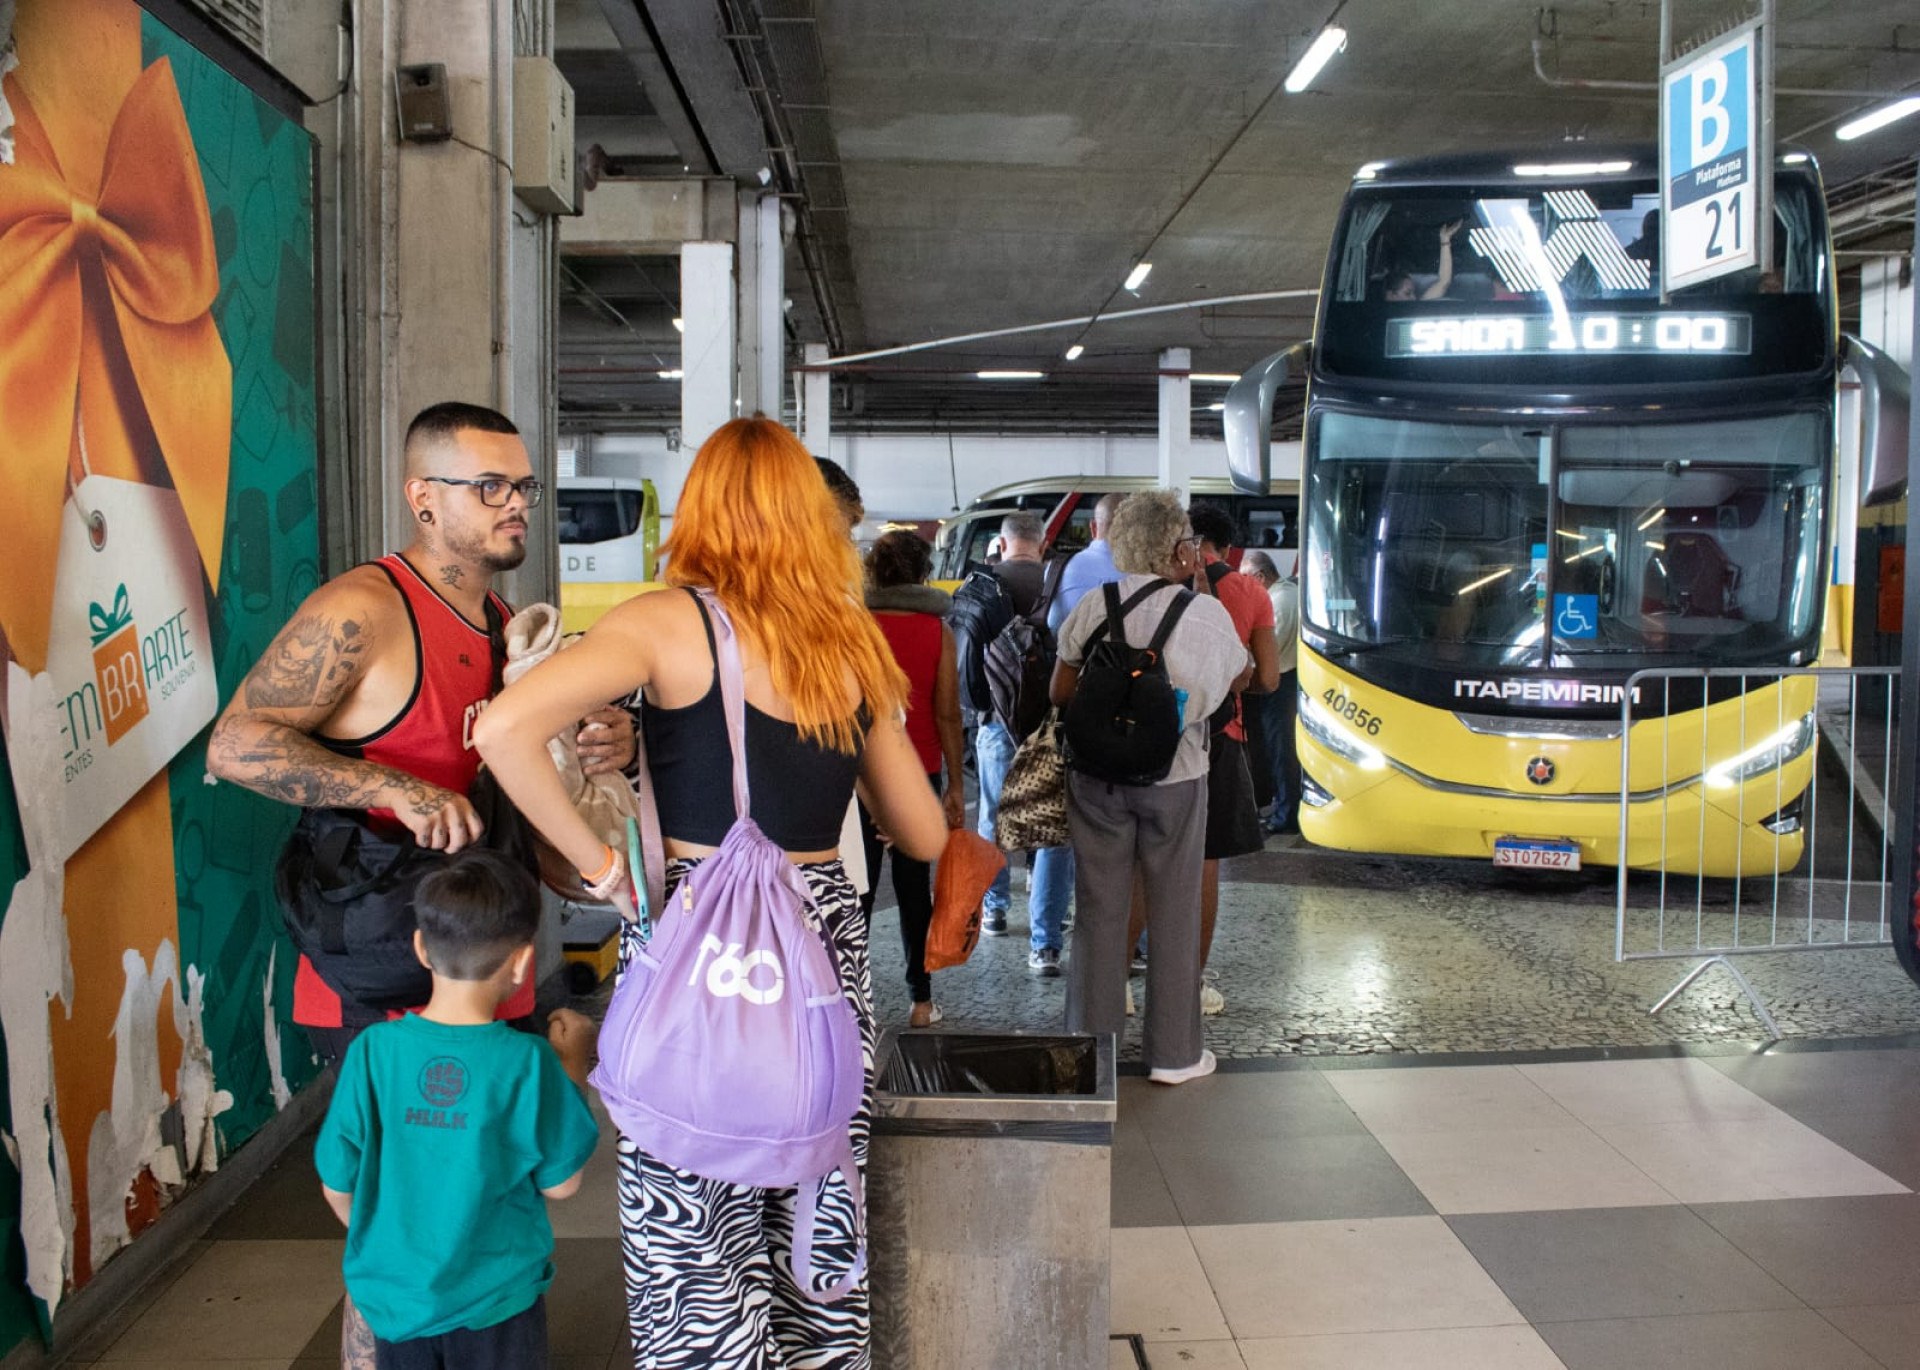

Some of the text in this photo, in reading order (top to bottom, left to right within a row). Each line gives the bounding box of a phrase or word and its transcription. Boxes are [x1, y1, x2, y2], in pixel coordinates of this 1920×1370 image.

[1691, 58, 1730, 168] B
[1695, 157, 1741, 186] Plataforma
[1706, 191, 1741, 259] 21
[1454, 679, 1641, 704] ITAPEMIRIM
[1322, 688, 1383, 736] 40856
[64, 749, 94, 783] ENTES
[404, 1106, 469, 1130] HULK
